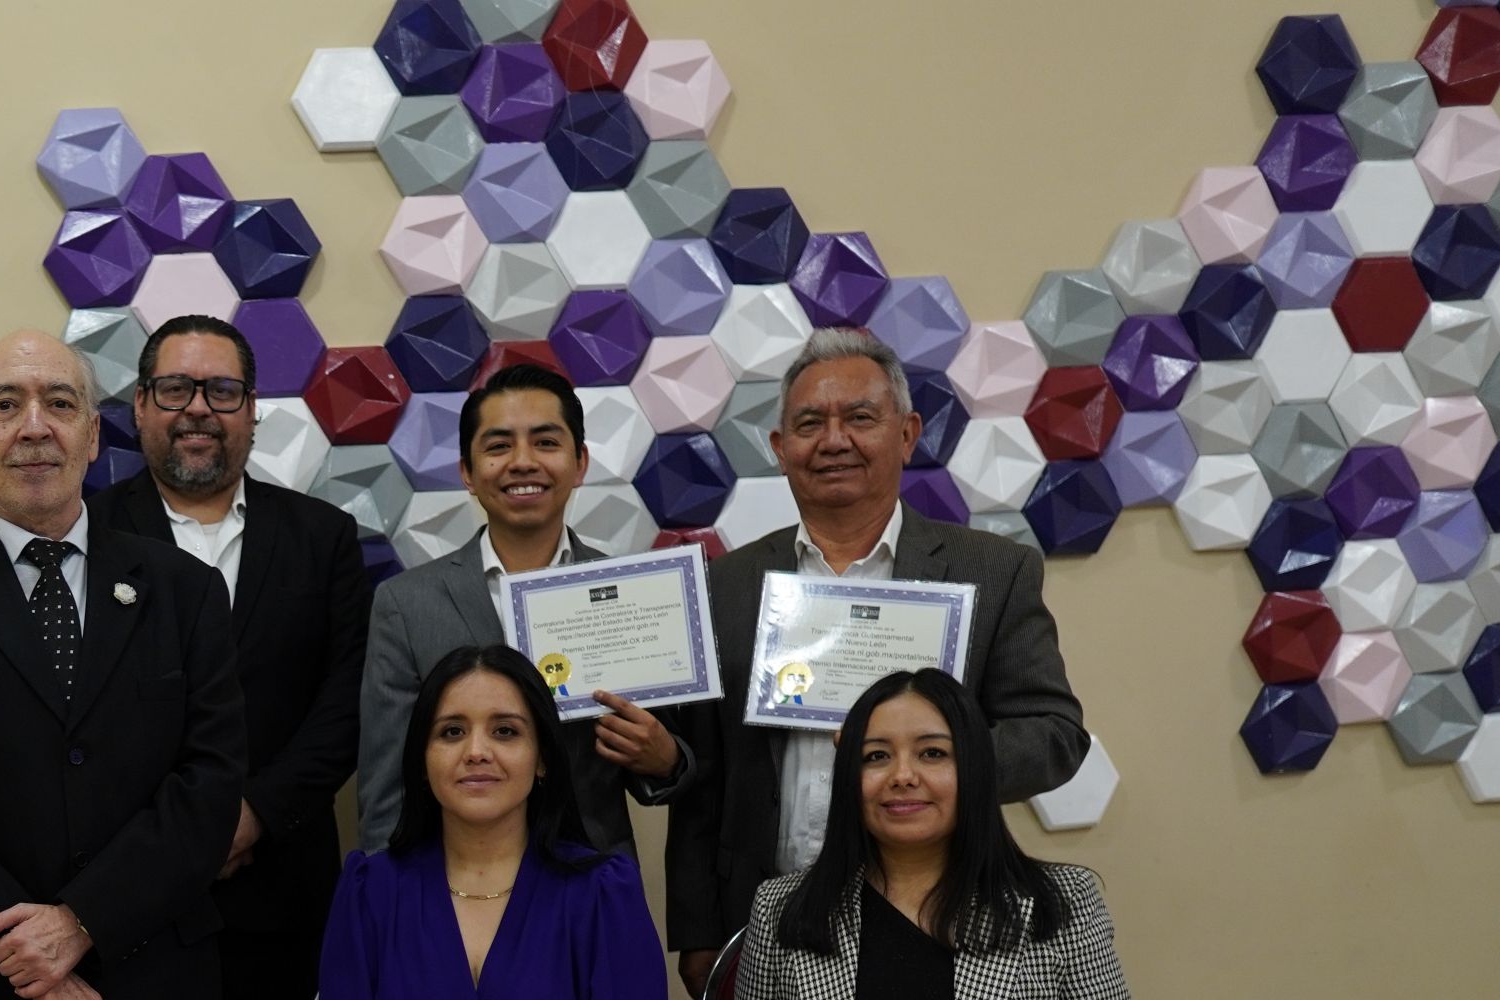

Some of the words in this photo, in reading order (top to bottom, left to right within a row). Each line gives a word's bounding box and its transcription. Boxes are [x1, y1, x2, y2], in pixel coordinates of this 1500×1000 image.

[603, 618, 624, 626] Estado
[562, 646, 585, 654] Premio
[586, 639, 627, 650] Internacional
[846, 639, 868, 647] Nuevo
[833, 662, 875, 671] Internacional
